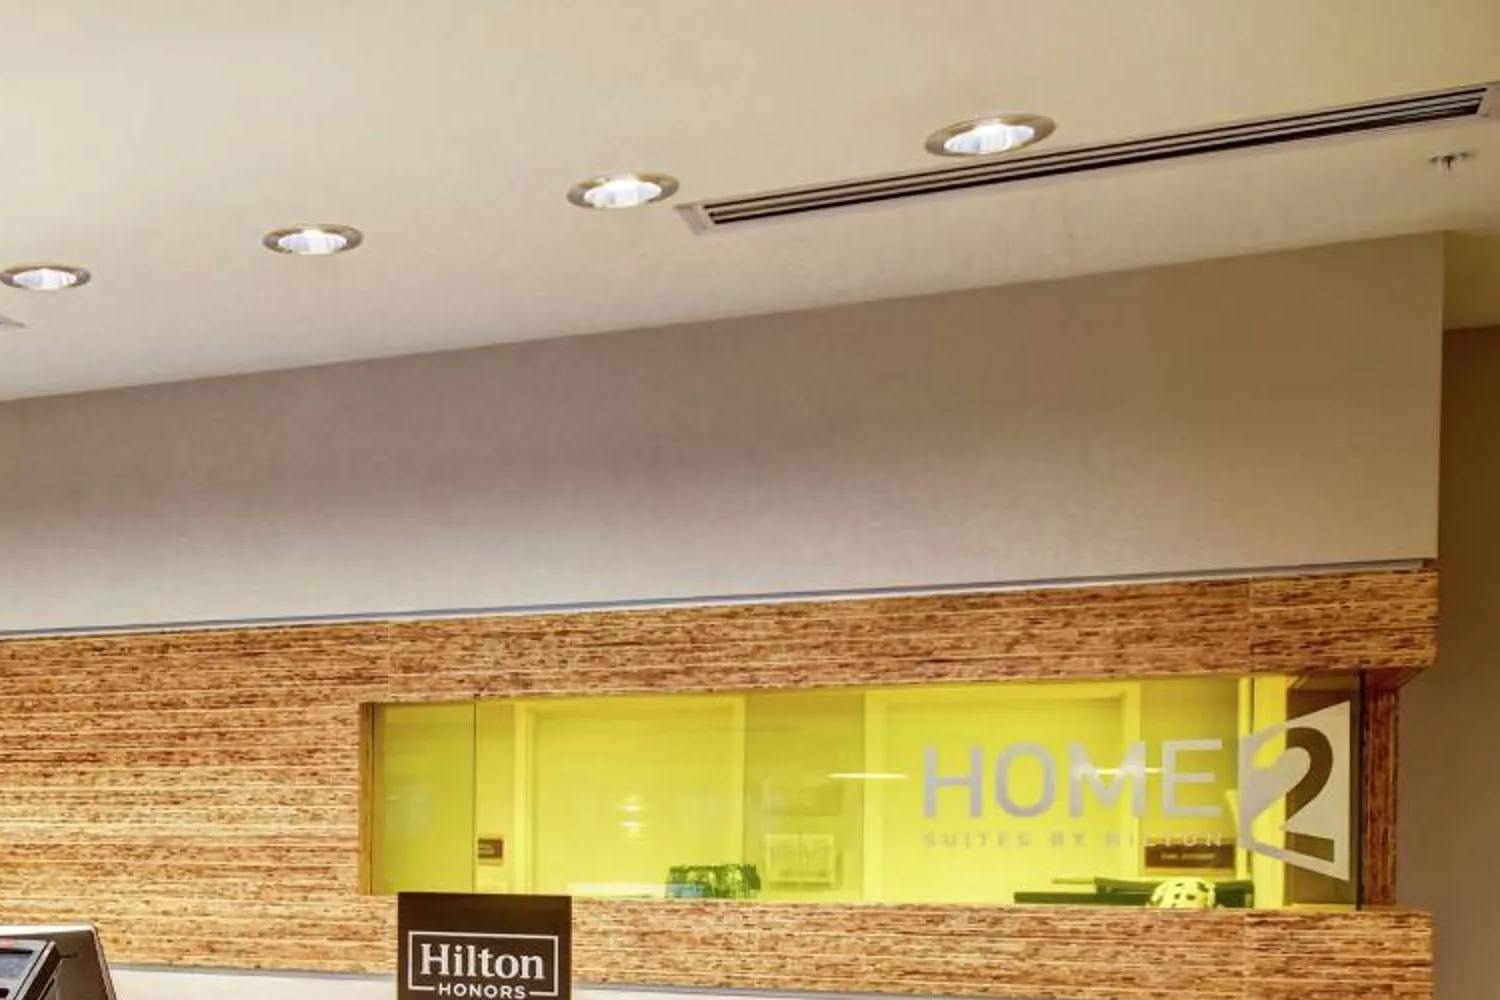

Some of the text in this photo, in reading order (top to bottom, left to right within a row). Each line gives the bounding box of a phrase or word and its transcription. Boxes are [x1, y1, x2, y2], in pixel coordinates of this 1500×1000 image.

[922, 831, 1030, 848] SUITES
[1050, 831, 1087, 848] BY
[420, 943, 545, 980] Hilton
[438, 983, 526, 1000] HONORS
